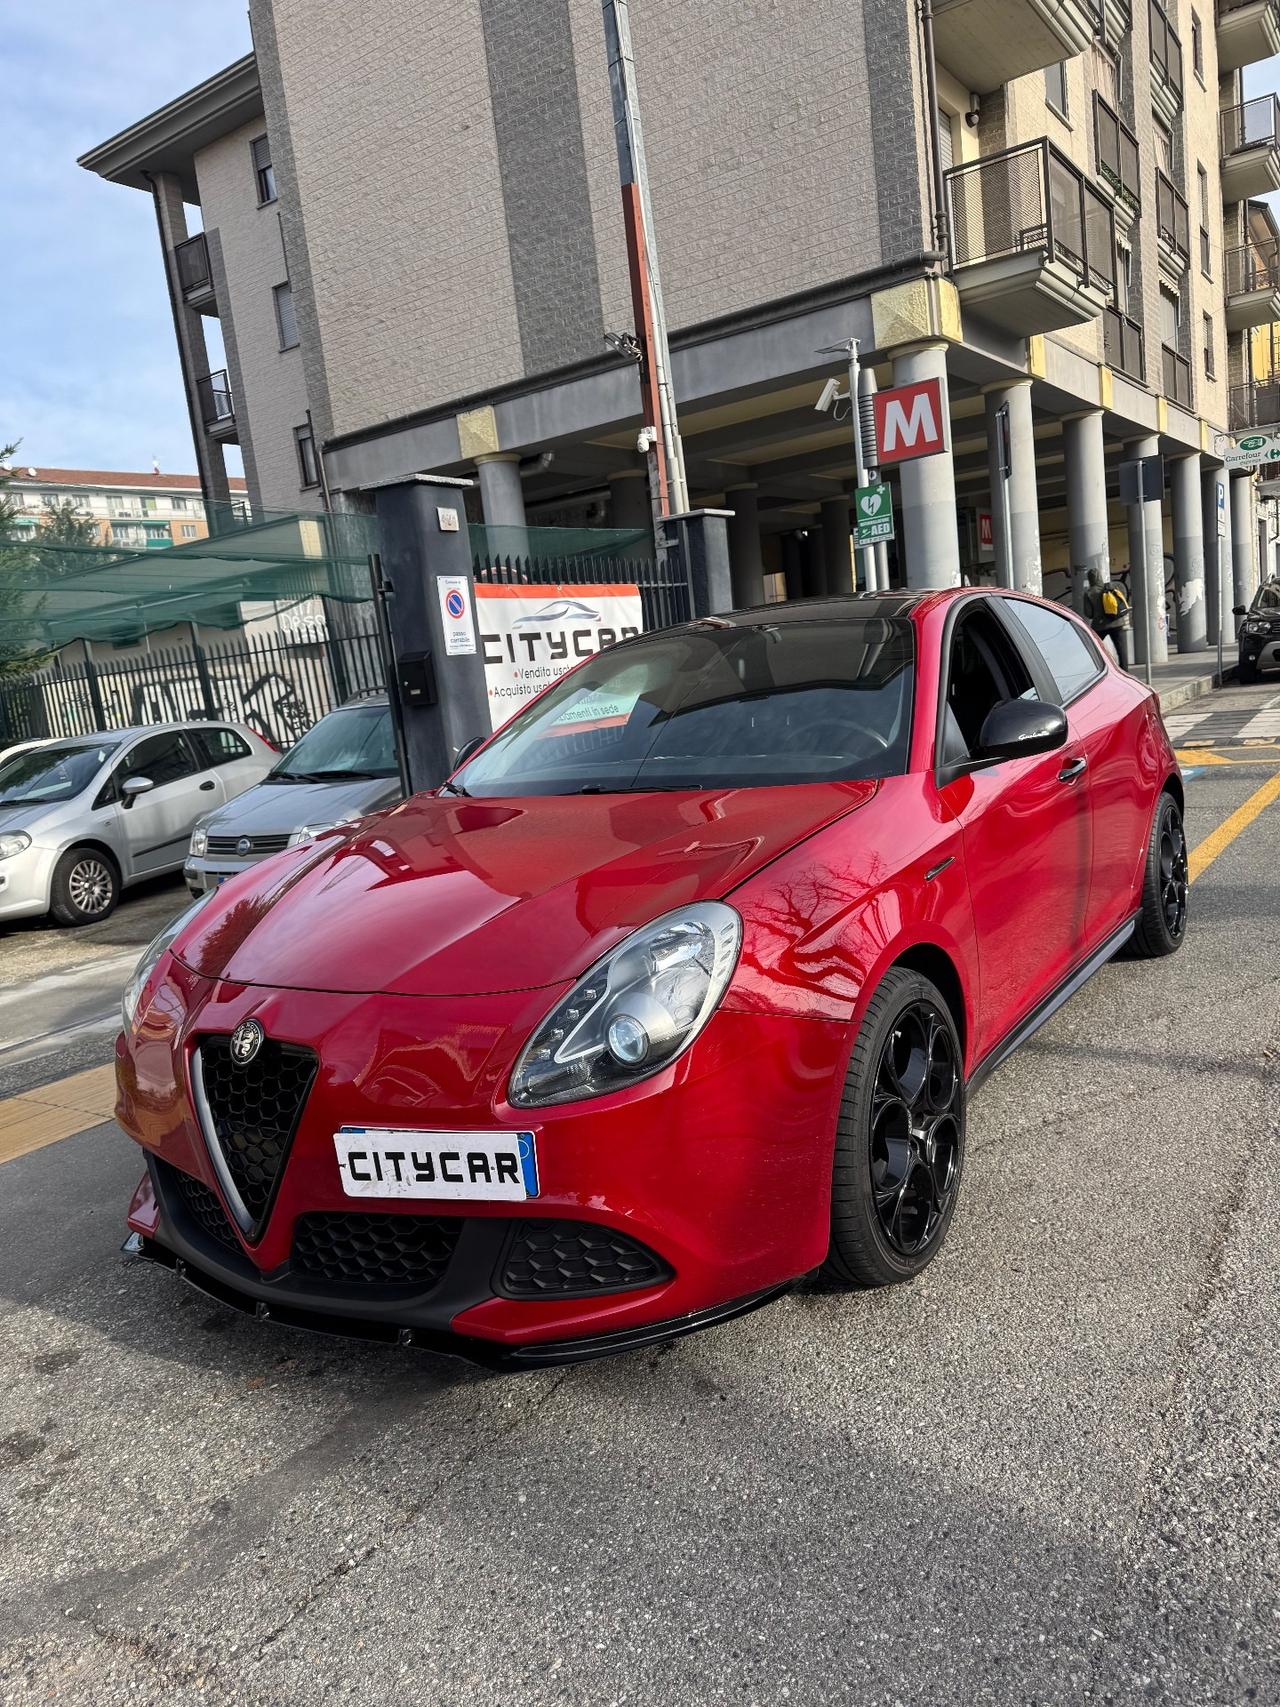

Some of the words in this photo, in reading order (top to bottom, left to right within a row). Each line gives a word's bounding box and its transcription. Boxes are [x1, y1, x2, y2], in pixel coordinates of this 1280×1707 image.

[883, 392, 938, 452] M
[1225, 451, 1262, 463] Carrefour
[1217, 484, 1224, 506] P
[871, 523, 890, 536] AED
[982, 519, 992, 539] M
[518, 666, 551, 679] Vendita
[553, 666, 573, 677] usa
[494, 683, 532, 698] Acquisto
[533, 682, 550, 694] usa
[601, 704, 619, 715] sede
[348, 1152, 520, 1183] CITYCAR
